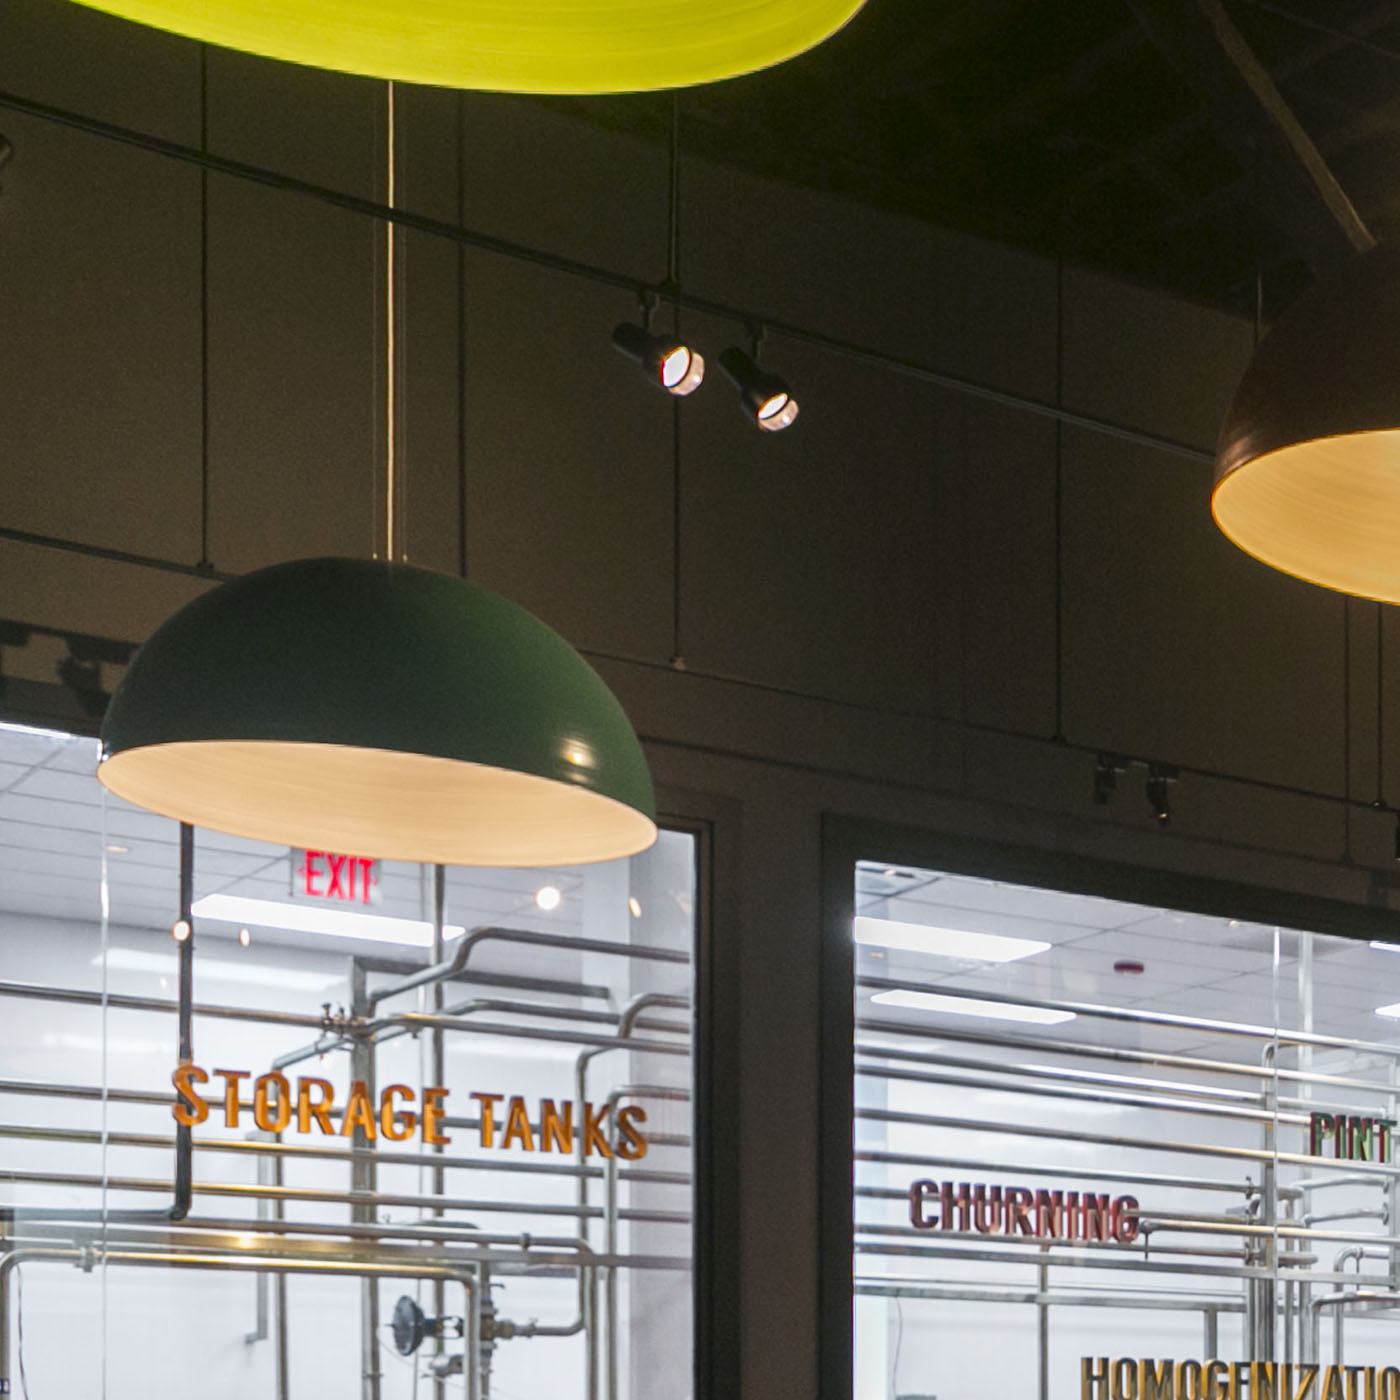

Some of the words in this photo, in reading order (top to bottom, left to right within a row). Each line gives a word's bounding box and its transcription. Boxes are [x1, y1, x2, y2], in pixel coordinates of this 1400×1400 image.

[303, 850, 375, 904] EXIT
[172, 1064, 451, 1146] STORAGE
[470, 1092, 649, 1161] TANKS
[1310, 1111, 1397, 1163] PINT
[909, 1179, 1140, 1244] CHURNING
